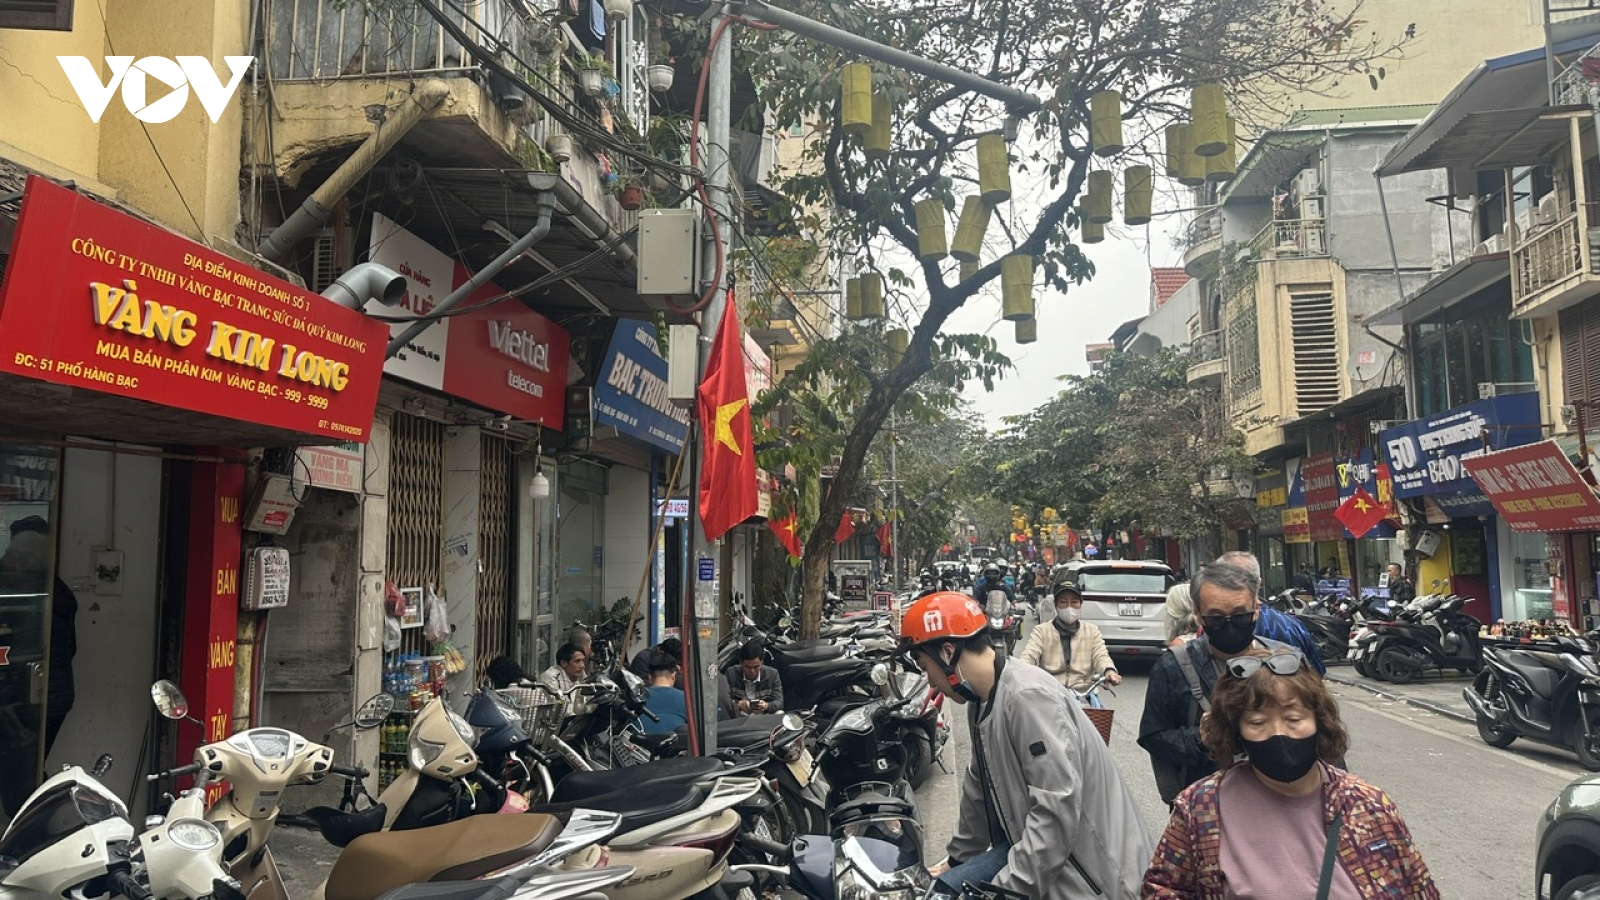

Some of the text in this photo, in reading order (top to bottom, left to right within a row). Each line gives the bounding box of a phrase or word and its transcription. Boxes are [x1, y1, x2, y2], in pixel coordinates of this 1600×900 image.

[71, 238, 116, 265] CÔNG
[119, 254, 138, 273] TY
[139, 262, 177, 287] TNHH
[178, 275, 213, 300] VÀNG
[213, 289, 237, 309] BẠC
[236, 295, 271, 320] TRANG
[272, 307, 292, 327] SỨC
[292, 315, 306, 332] ĐÁ
[307, 322, 326, 338] QUÝ
[325, 331, 343, 346] KIM
[343, 335, 367, 354] LONG
[183, 253, 311, 311] ĐỊA ĐIỂM KINH DOANH SỐ 1
[89, 279, 198, 347] VÀNG
[206, 320, 276, 372] KIM
[277, 343, 350, 392] LONG
[487, 319, 550, 374] Viettel
[14, 352, 139, 390] ĐC: 51 PHỐ HÀNG BẠC
[95, 339, 131, 362] MUA
[132, 349, 163, 370] BÁN
[163, 358, 200, 378] PHÂN
[200, 367, 223, 384] KIM
[226, 372, 256, 392] VÀNG
[257, 381, 279, 400] BẠC
[284, 388, 301, 403] 999
[307, 393, 329, 410] 9999
[507, 369, 544, 399] telecom
[607, 351, 642, 396] BẠC
[1386, 435, 1418, 471] 50
[216, 562, 237, 595] BÁN
[210, 635, 235, 669] VÀNG
[210, 708, 228, 742] TÂY
